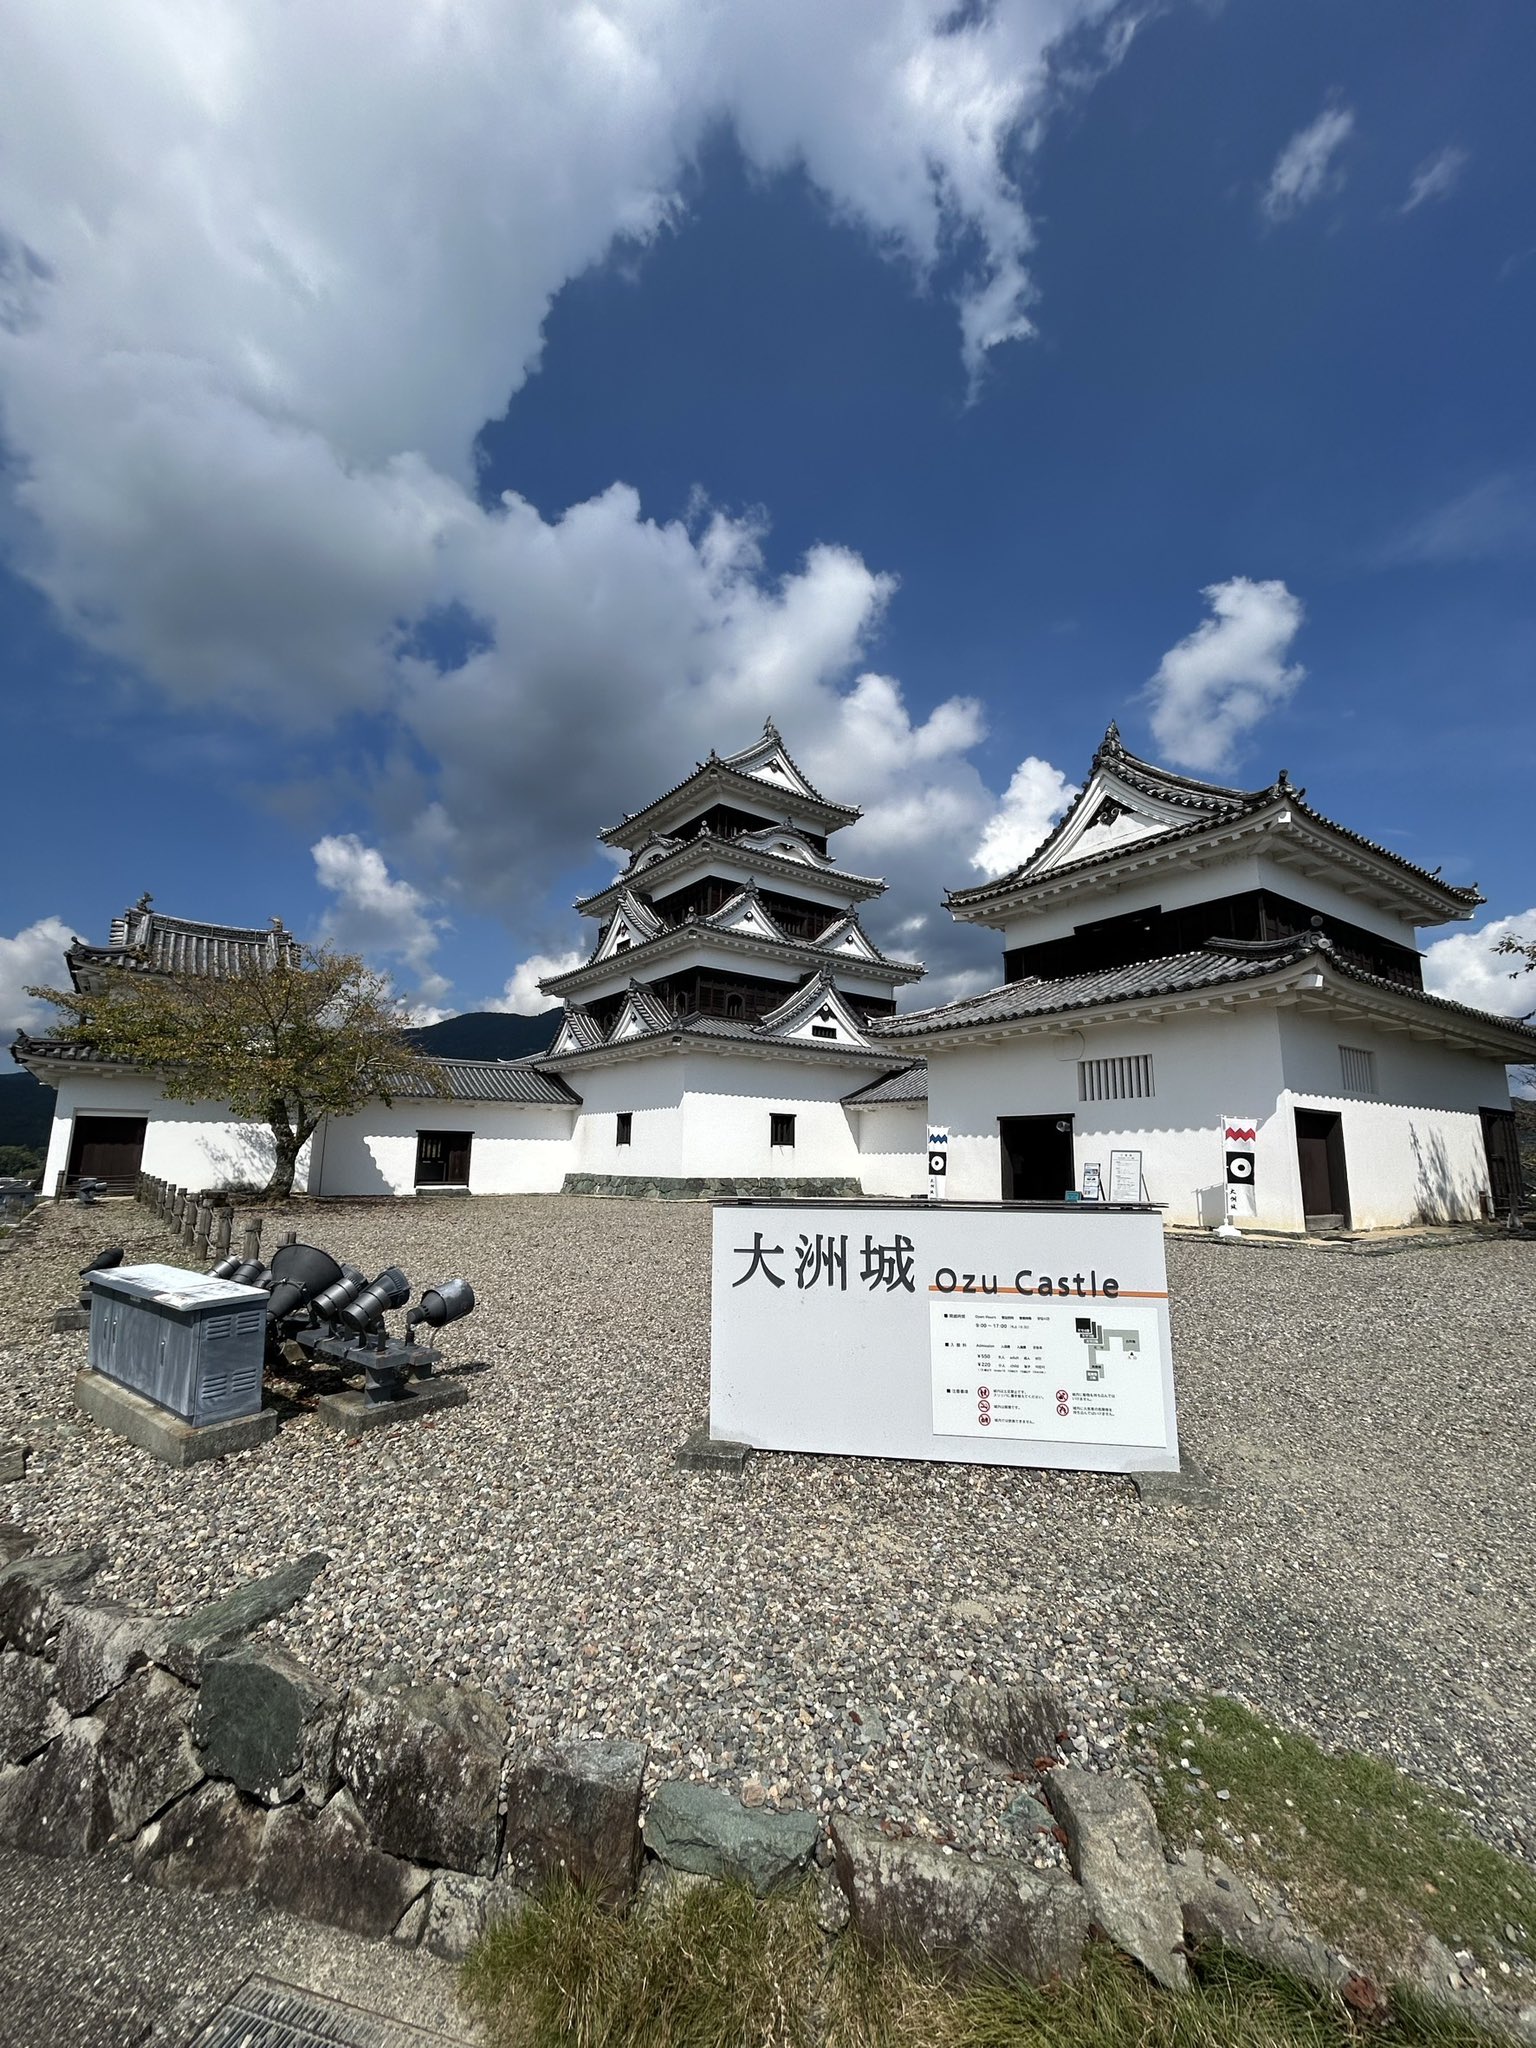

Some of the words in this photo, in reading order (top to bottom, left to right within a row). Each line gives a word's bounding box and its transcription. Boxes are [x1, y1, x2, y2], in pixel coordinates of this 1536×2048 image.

[732, 1231, 916, 1293] 大洲城
[935, 1267, 998, 1295] Ozu
[1015, 1269, 1119, 1298] Castle
